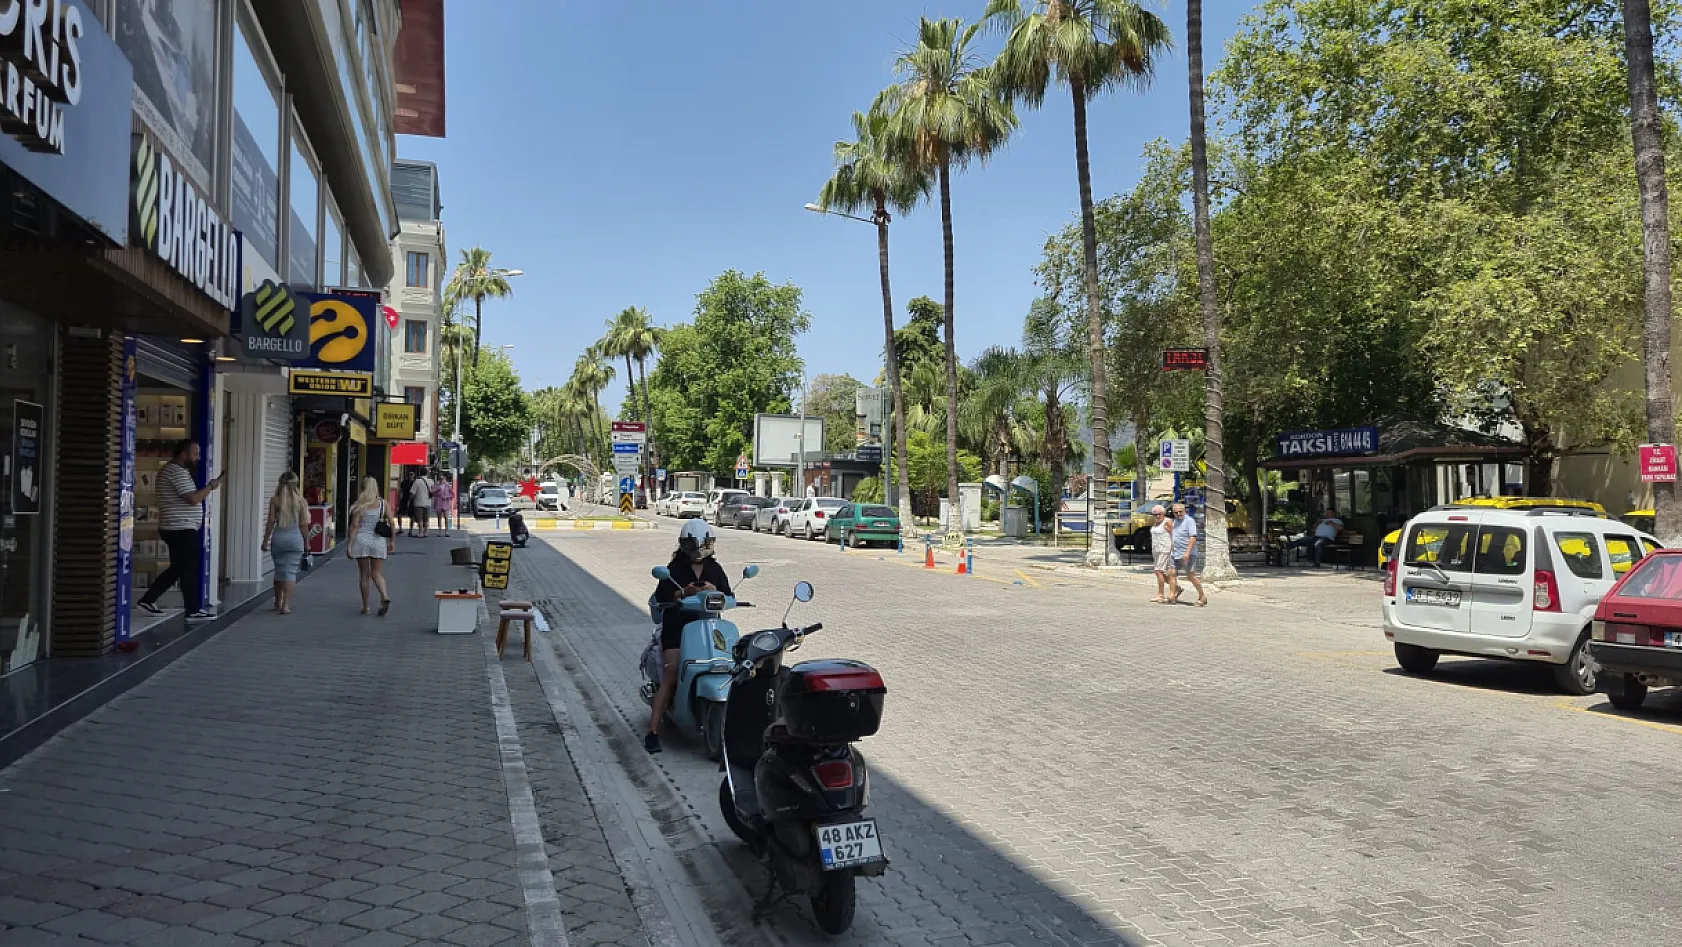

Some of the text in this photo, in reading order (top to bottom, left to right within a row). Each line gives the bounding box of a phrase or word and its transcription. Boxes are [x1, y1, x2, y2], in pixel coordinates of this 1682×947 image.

[0, 60, 65, 156] RFUM
[158, 151, 238, 312] BARGELLO
[248, 336, 302, 353] BARGELLO
[296, 376, 337, 385] WESTERN
[821, 823, 875, 845] 48 AKZ
[835, 842, 863, 861] 627
